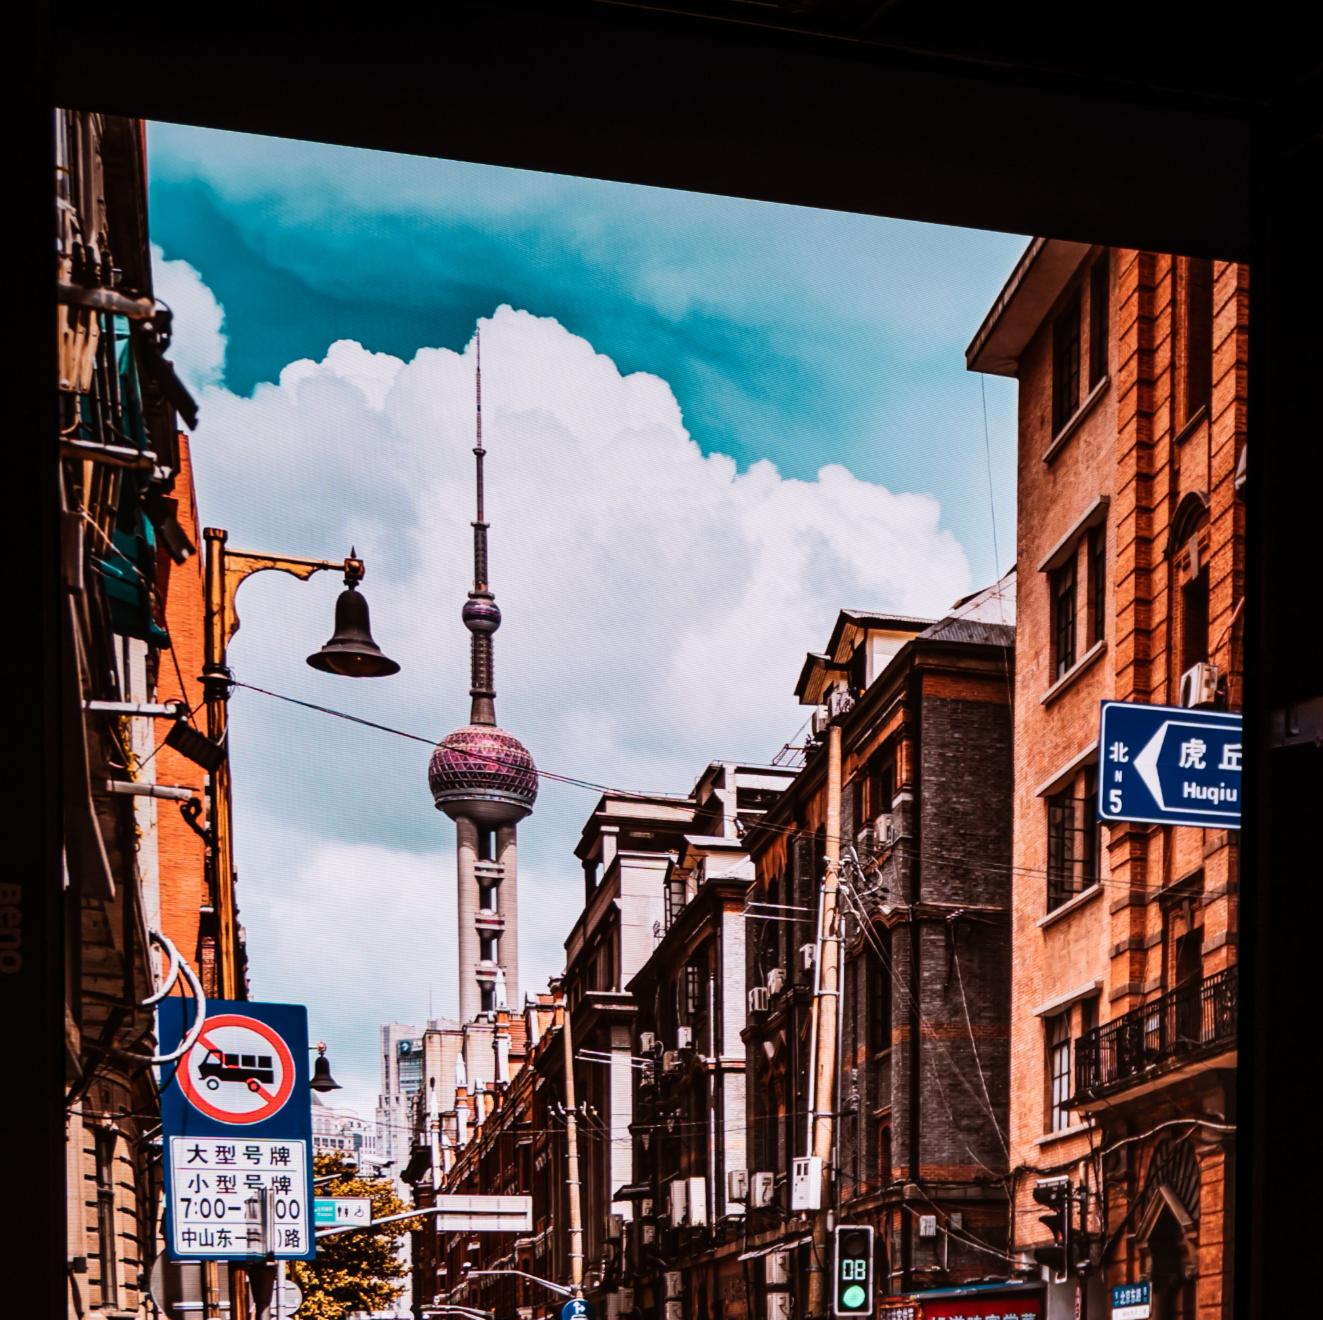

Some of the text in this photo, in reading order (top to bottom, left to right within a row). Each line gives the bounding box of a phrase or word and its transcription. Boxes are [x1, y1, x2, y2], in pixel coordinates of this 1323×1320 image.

[1109, 742, 1129, 763] 北
[1110, 789, 1122, 813] 5
[1183, 782, 1238, 805] Huqiu
[187, 1144, 291, 1166] 大型号牌
[188, 1174, 292, 1195] 小型号牌
[842, 1259, 866, 1281] 08
